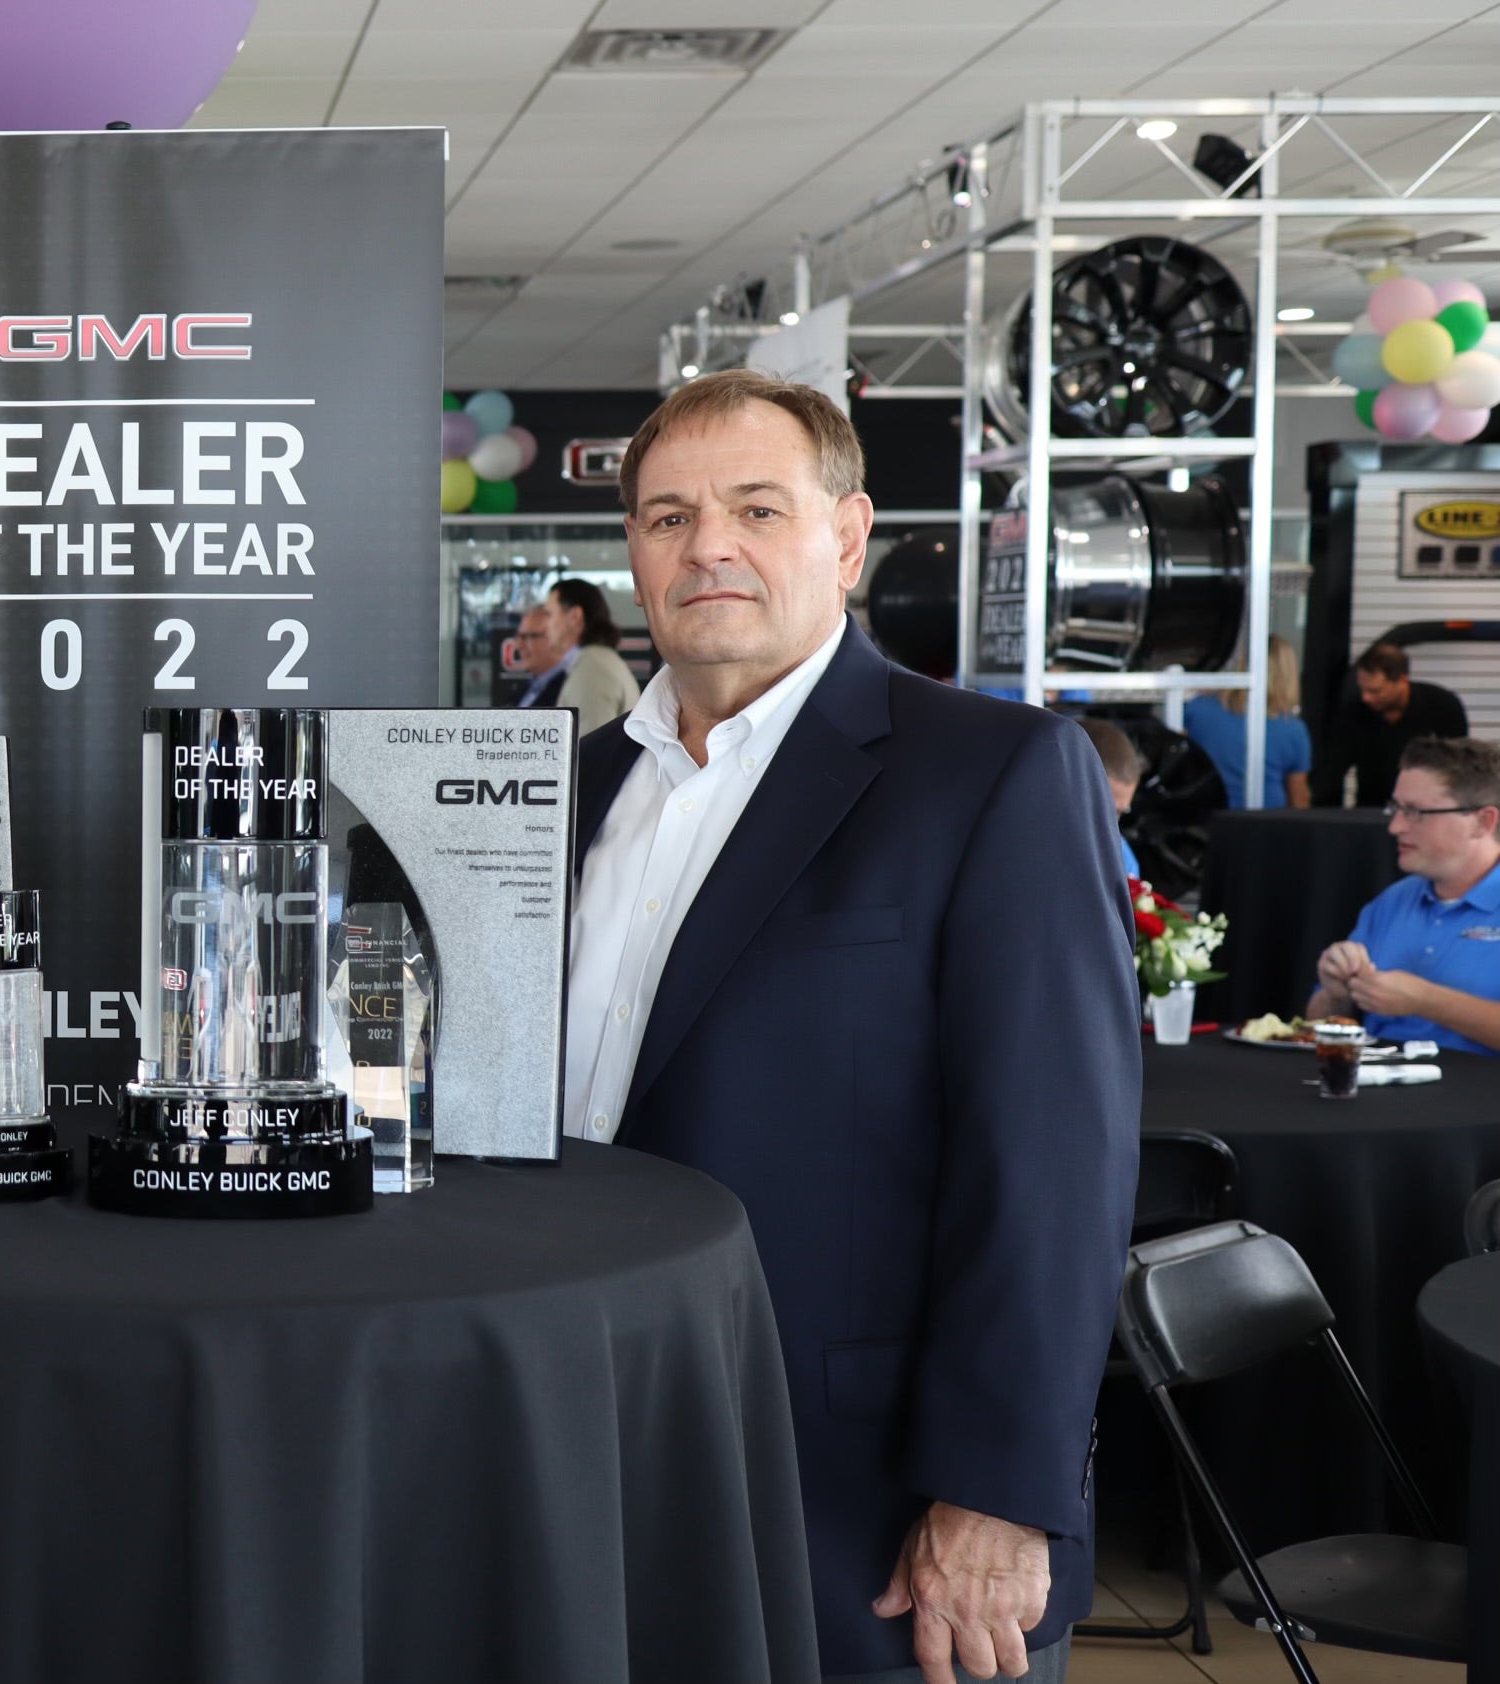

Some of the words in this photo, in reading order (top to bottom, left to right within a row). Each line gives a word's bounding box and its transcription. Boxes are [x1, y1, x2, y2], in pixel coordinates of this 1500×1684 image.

[17, 523, 135, 576] THE
[149, 522, 316, 576] YEAR
[986, 556, 1025, 592] 202
[387, 728, 457, 744] CONLEY
[462, 728, 514, 744] BUICK
[520, 728, 559, 744] GMC
[175, 745, 265, 767] DEALER
[544, 750, 559, 761] FL
[174, 778, 203, 800] OF
[208, 778, 254, 800] THE
[259, 778, 317, 800] YEAR
[435, 779, 559, 806] GMC
[525, 824, 555, 834] Honors
[171, 891, 318, 924] GMC
[10, 931, 41, 946] YEAR
[368, 1028, 393, 1040] 2022
[169, 1109, 218, 1128] JEFF
[222, 1107, 300, 1128] CONLEY
[30, 1170, 52, 1182] GMC
[133, 1169, 215, 1192] CONLEY
[219, 1171, 283, 1192] BUICK
[287, 1170, 331, 1191] GMC
